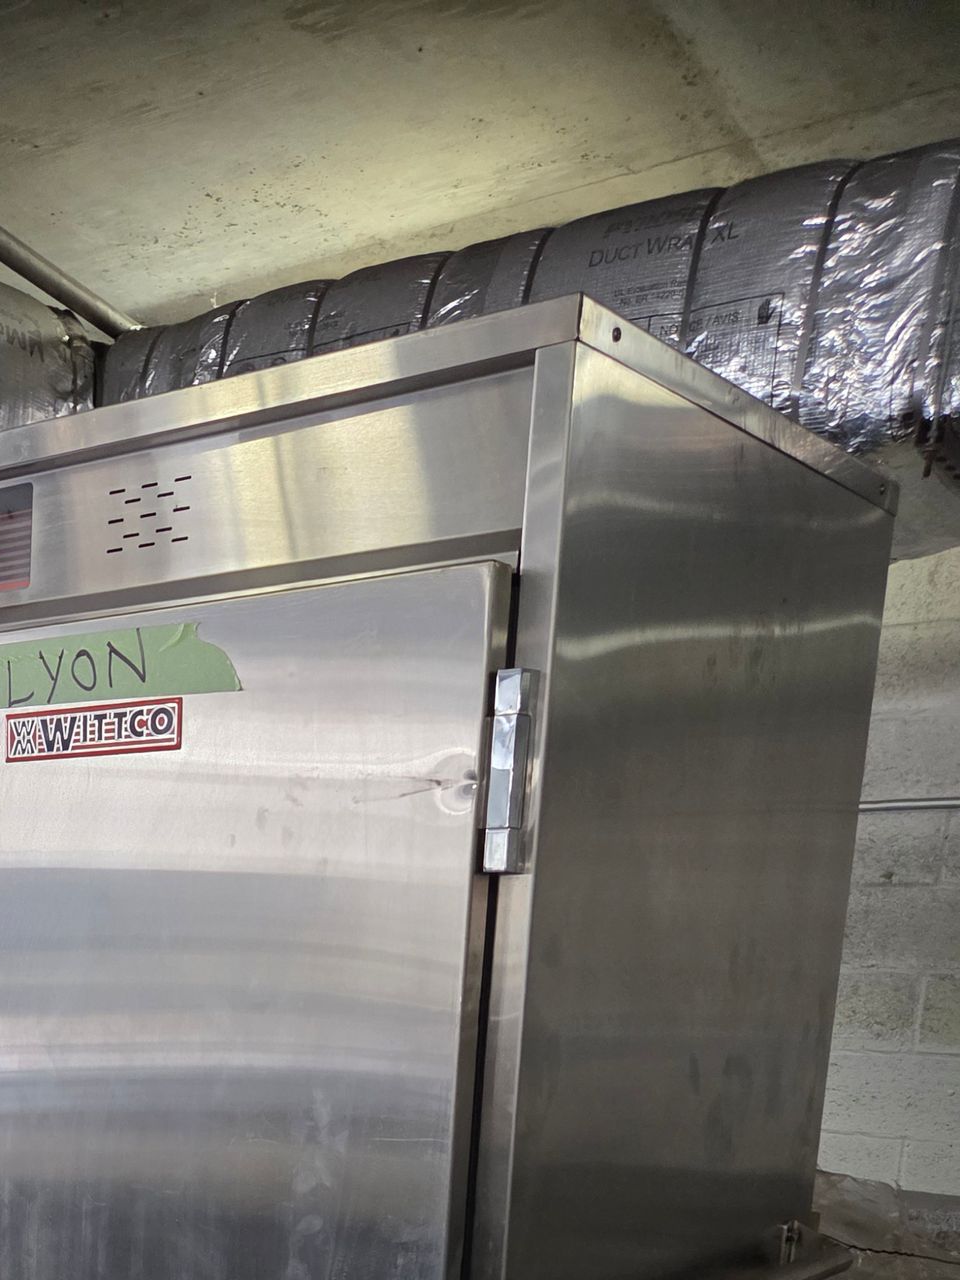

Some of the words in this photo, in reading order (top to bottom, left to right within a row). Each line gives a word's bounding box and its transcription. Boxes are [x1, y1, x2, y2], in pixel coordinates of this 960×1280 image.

[588, 244, 643, 268] DUCT
[647, 234, 695, 256] WRA
[711, 221, 739, 245] XL
[7, 627, 147, 708] LYON
[40, 706, 175, 753] WITTCO
